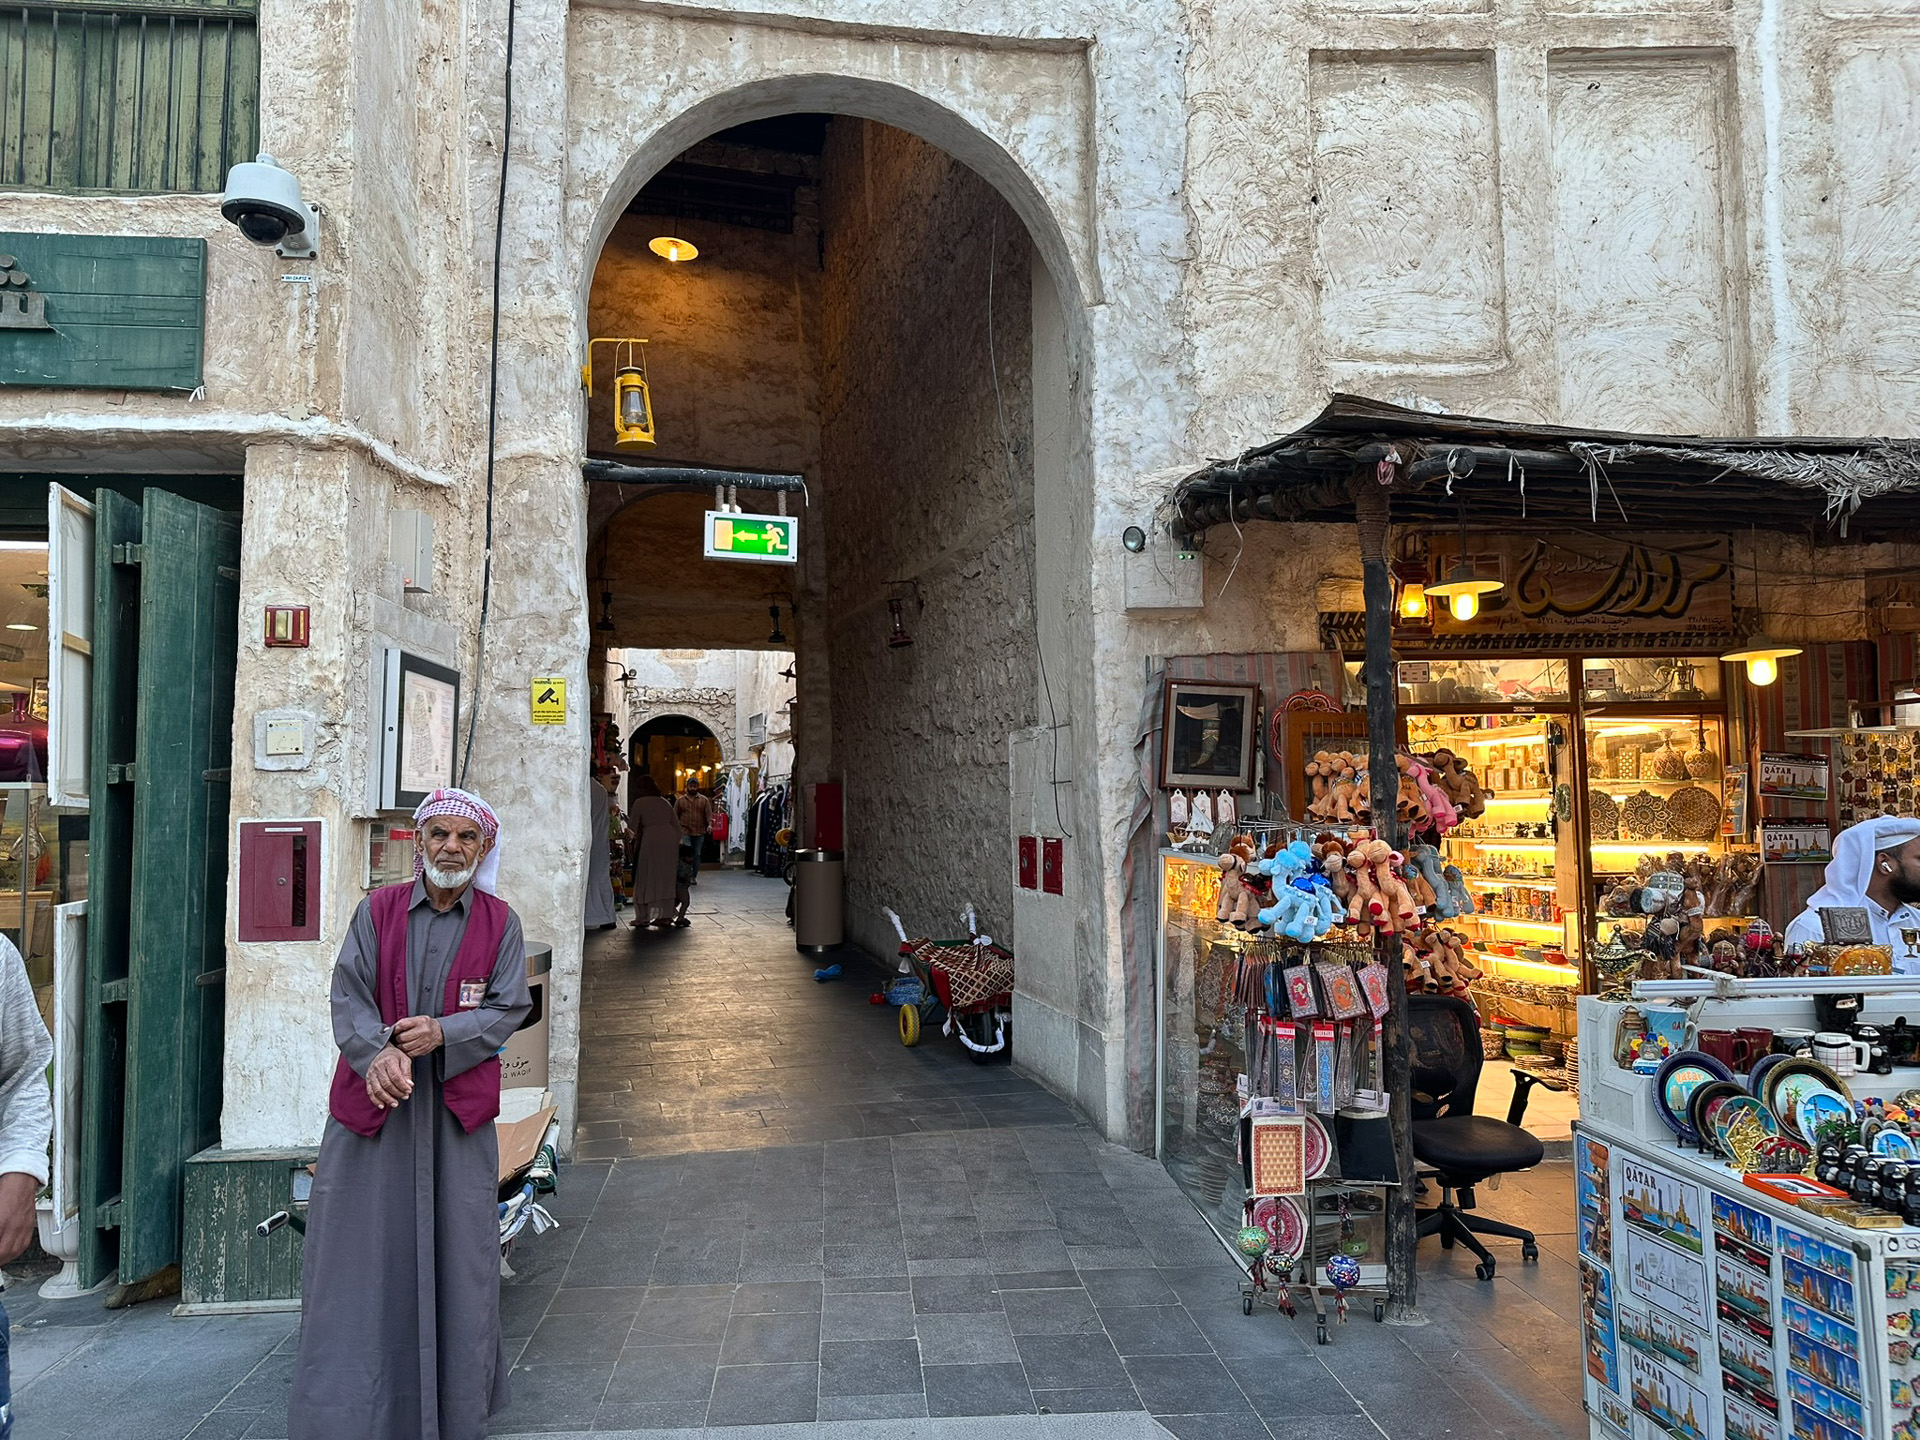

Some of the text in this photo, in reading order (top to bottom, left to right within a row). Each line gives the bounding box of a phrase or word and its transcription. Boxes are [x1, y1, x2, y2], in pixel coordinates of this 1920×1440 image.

[1764, 766, 1792, 775] QATAR
[1766, 833, 1795, 842] QATAR
[511, 1056, 530, 1069] سوق
[1625, 1166, 1657, 1190] QATAR
[1633, 1354, 1666, 1386] QATAR
